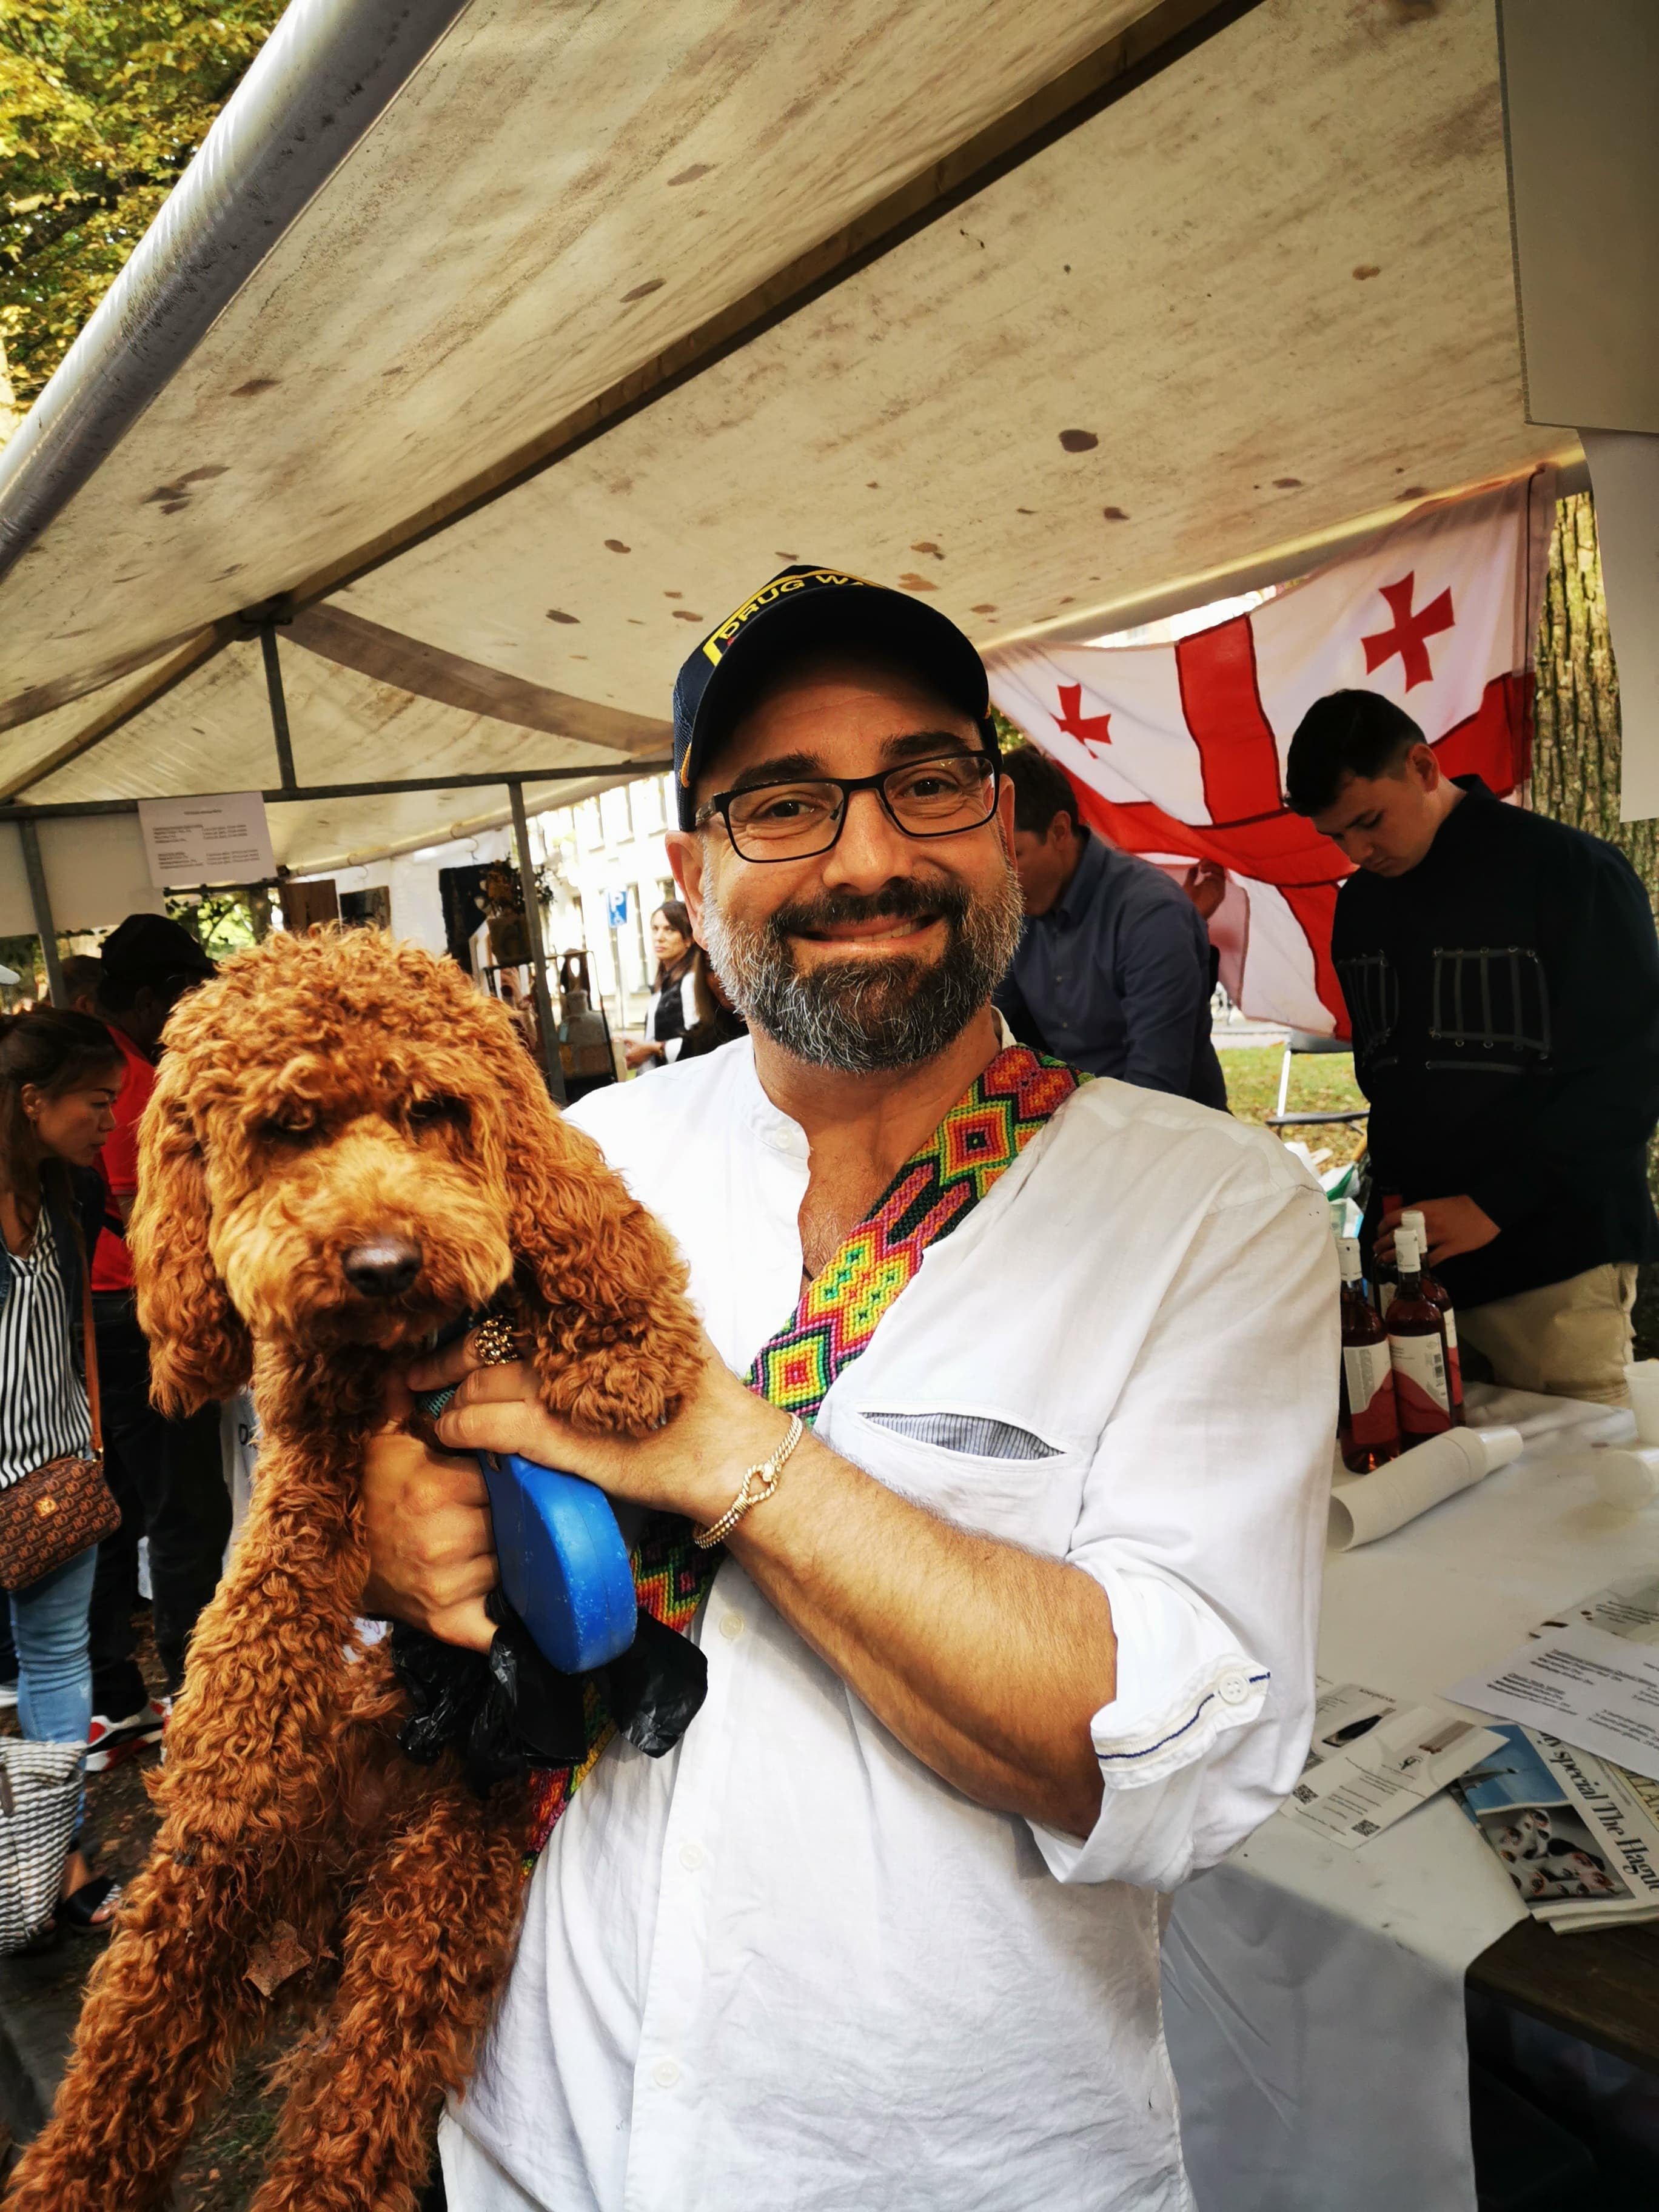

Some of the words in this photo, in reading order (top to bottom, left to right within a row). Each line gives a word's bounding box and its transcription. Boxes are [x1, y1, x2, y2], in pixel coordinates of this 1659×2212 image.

[719, 580, 805, 640] DRUG
[610, 891, 624, 912] P
[1549, 1750, 1609, 1800] special
[1591, 1801, 1625, 1835] The
